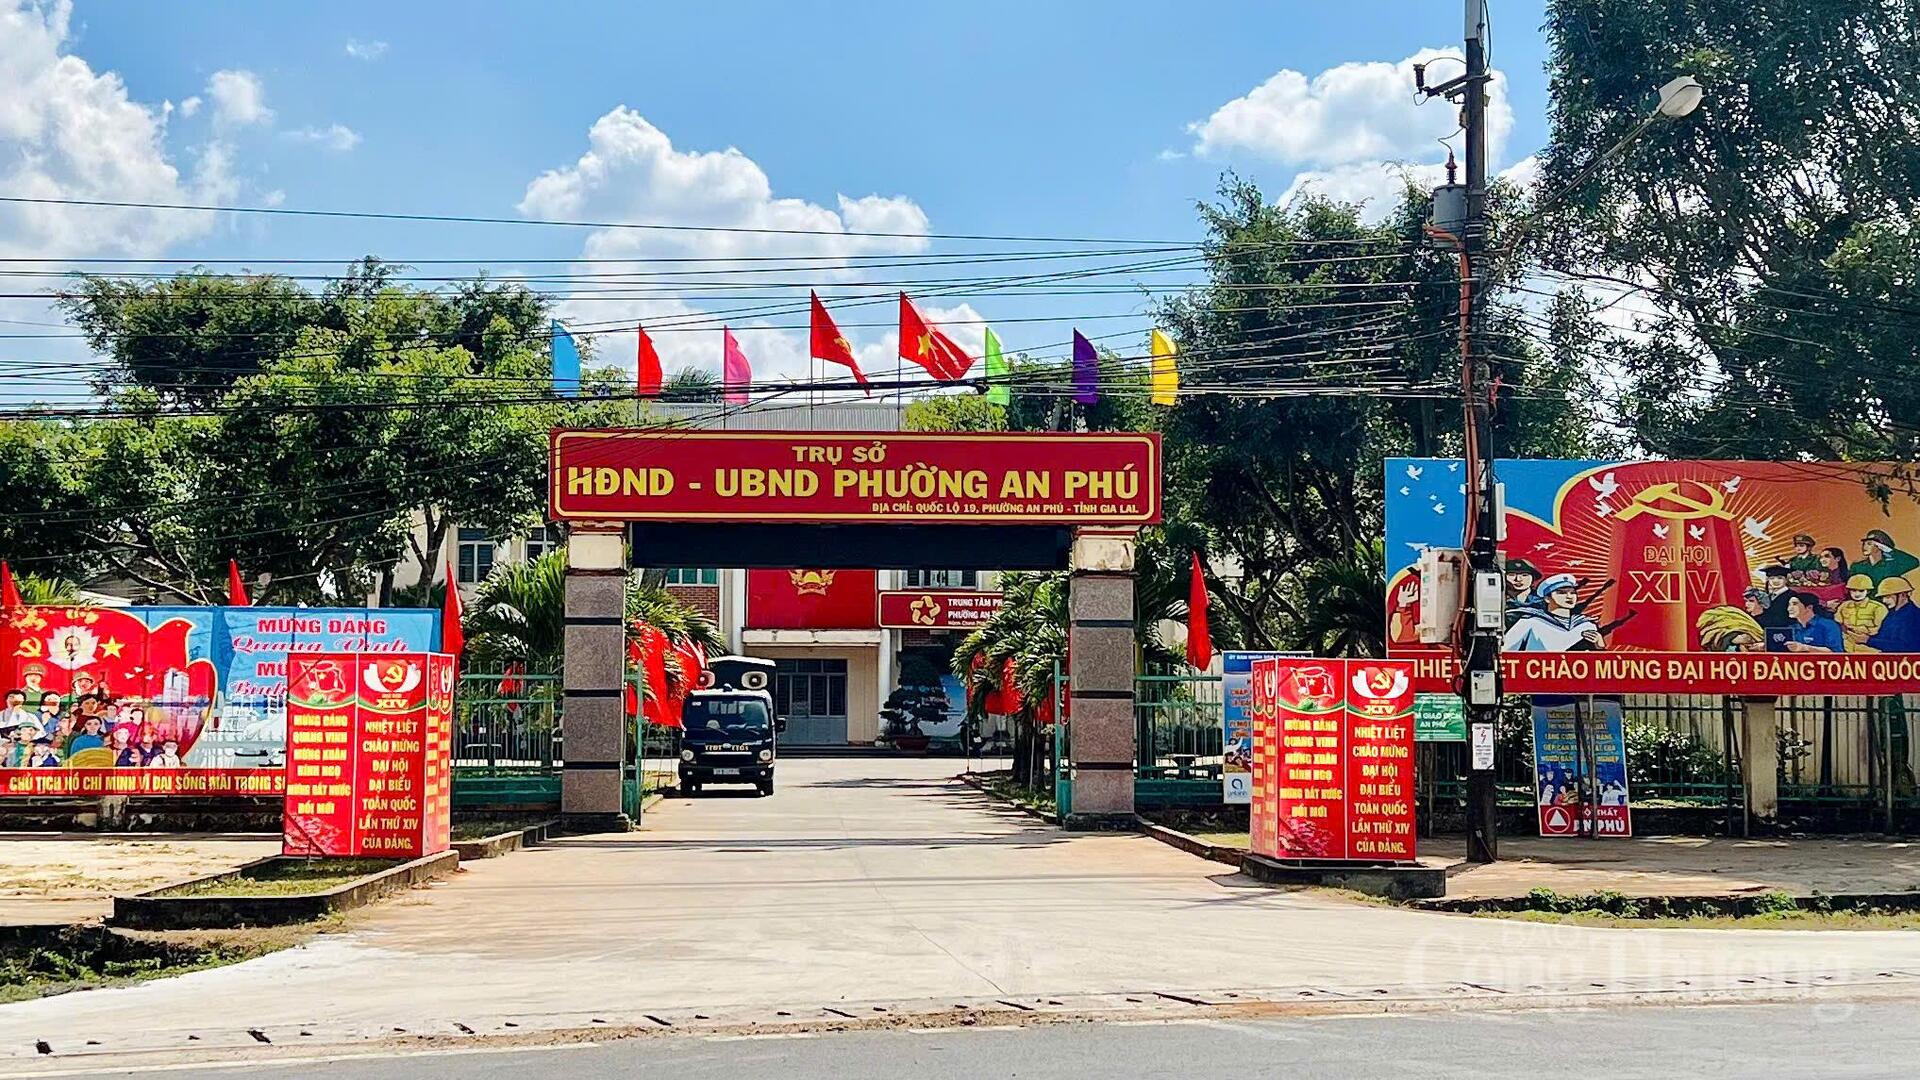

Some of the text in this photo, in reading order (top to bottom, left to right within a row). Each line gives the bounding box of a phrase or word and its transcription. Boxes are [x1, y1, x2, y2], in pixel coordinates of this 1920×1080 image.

[791, 441, 887, 466] TRỤ SỞ
[567, 466, 675, 496] HĐND
[715, 468, 819, 497] UBND
[833, 461, 988, 498] PHƯỜNG
[1000, 470, 1050, 498] AN
[1064, 463, 1139, 499] PHÚ
[982, 500, 1024, 514] PHƯỜNG
[1026, 504, 1041, 513] AN
[1043, 501, 1064, 513] PHÚ
[1100, 503, 1117, 514] GIA
[1643, 543, 1712, 566] ĐẠI HỘI
[1628, 571, 1719, 604] XIV
[948, 598, 973, 607] TRUNG
[1526, 655, 1588, 680] CHÀO
[1595, 655, 1662, 680] MỪNG
[1667, 659, 1704, 684] ĐẠI
[1711, 657, 1748, 685] HỘI
[1753, 656, 1815, 681] ĐẢNG
[1817, 656, 1867, 680] TOÀN
[402, 819, 418, 830] XIV
[1395, 823, 1410, 834] XIV
[1598, 816, 1625, 832] PHÚ
